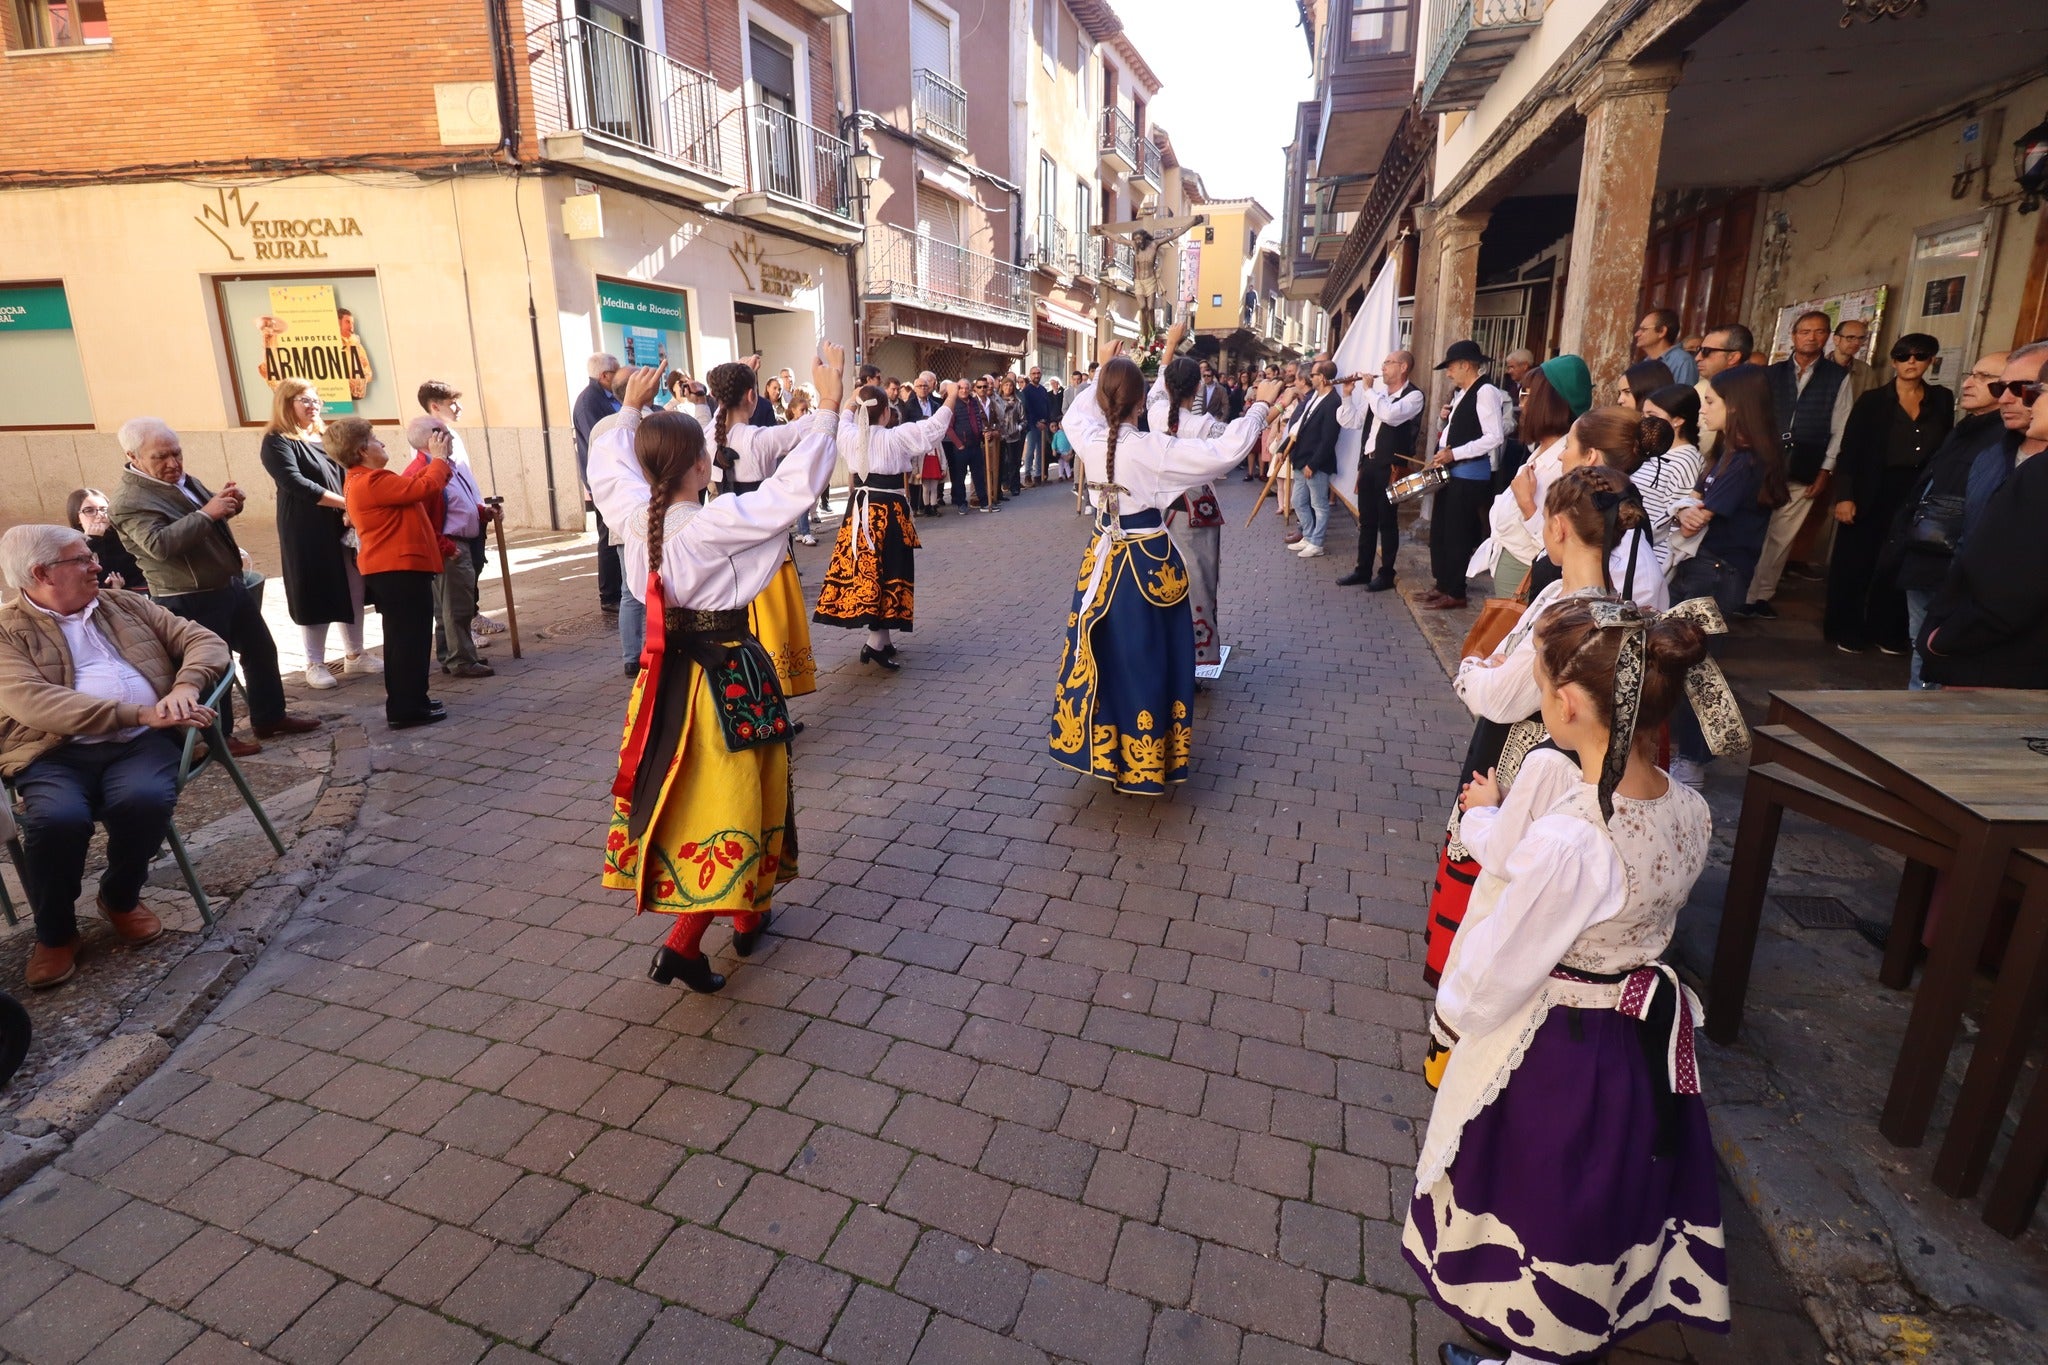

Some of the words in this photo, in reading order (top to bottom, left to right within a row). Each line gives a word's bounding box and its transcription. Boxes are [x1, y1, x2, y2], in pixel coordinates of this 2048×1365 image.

[251, 217, 363, 239] EUROCAJA
[253, 239, 328, 260] RURAL
[1187, 241, 1200, 249] PAN
[0, 306, 27, 314] OCAJA
[636, 302, 647, 312] de
[265, 345, 366, 381] ARMONÍA
